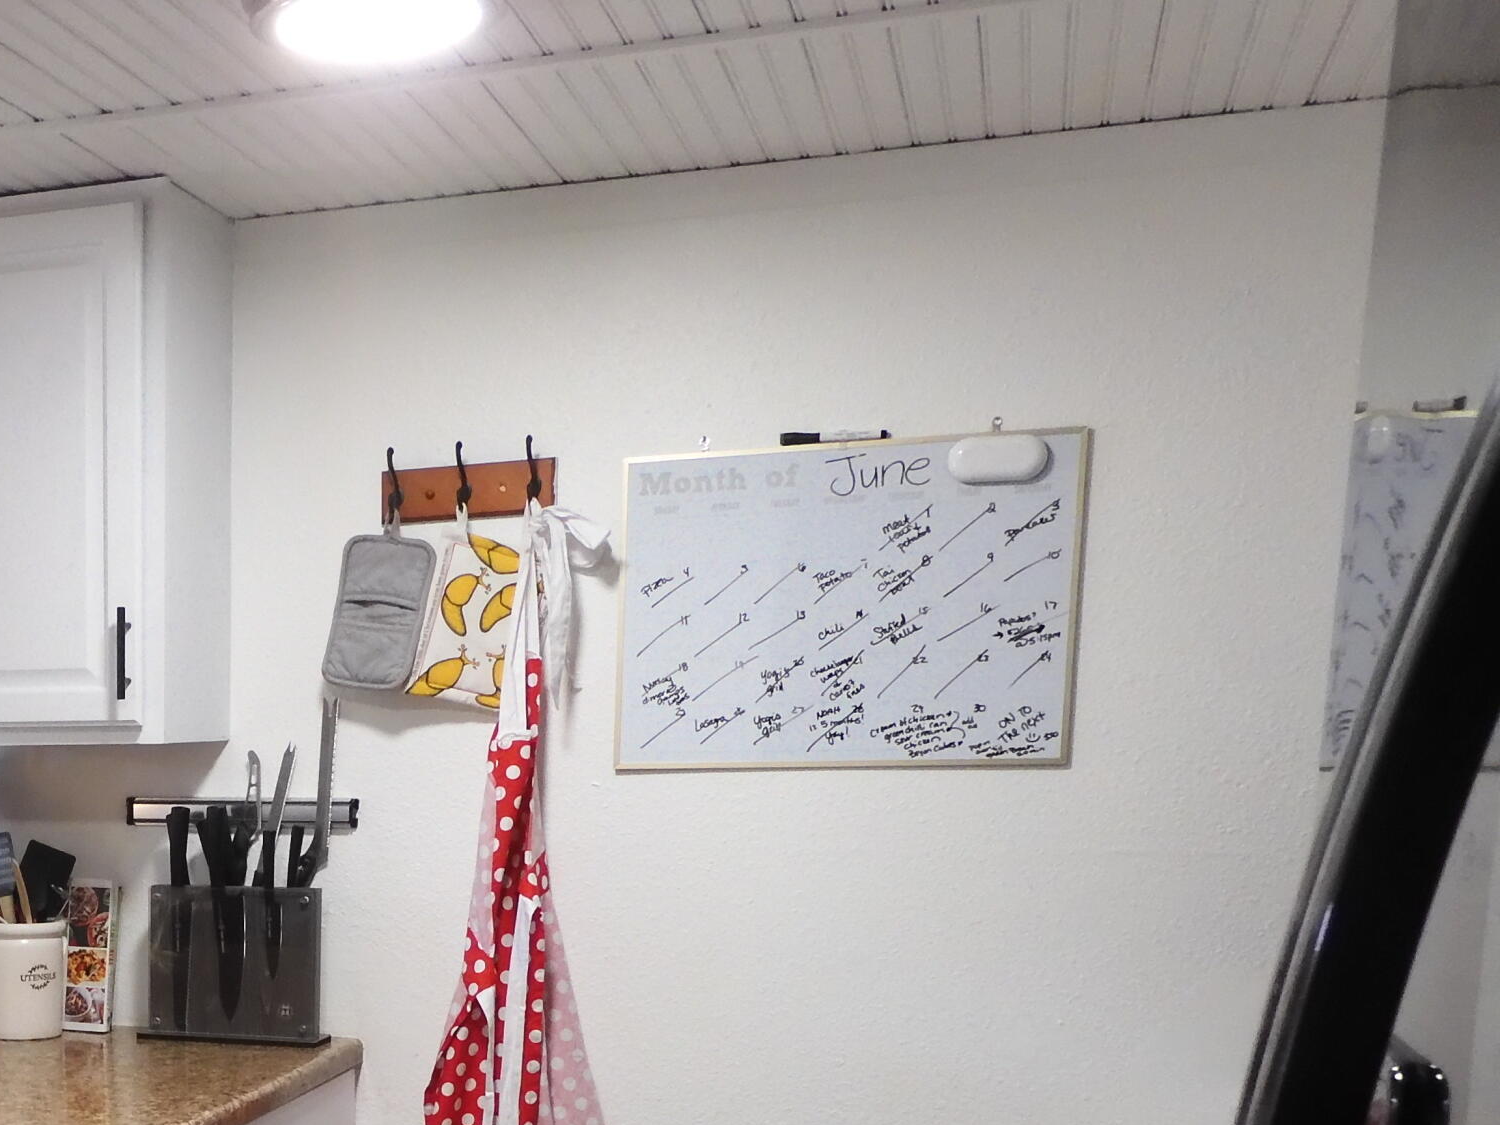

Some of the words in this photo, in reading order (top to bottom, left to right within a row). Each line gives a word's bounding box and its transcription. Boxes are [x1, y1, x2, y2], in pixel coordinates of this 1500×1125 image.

[639, 467, 747, 496] Month
[765, 464, 800, 487] of
[823, 453, 931, 497] June
[986, 502, 997, 513] 2
[987, 552, 994, 563] 9
[1047, 549, 1061, 560] 10
[683, 566, 690, 577] 4
[918, 606, 929, 615] 15
[980, 602, 994, 614] 16
[1045, 600, 1058, 610] 17
[739, 613, 749, 624] 12
[796, 610, 806, 620] 13
[912, 655, 928, 664] 22
[678, 662, 689, 672] 18
[910, 704, 923, 713] 29
[973, 703, 987, 713] 30
